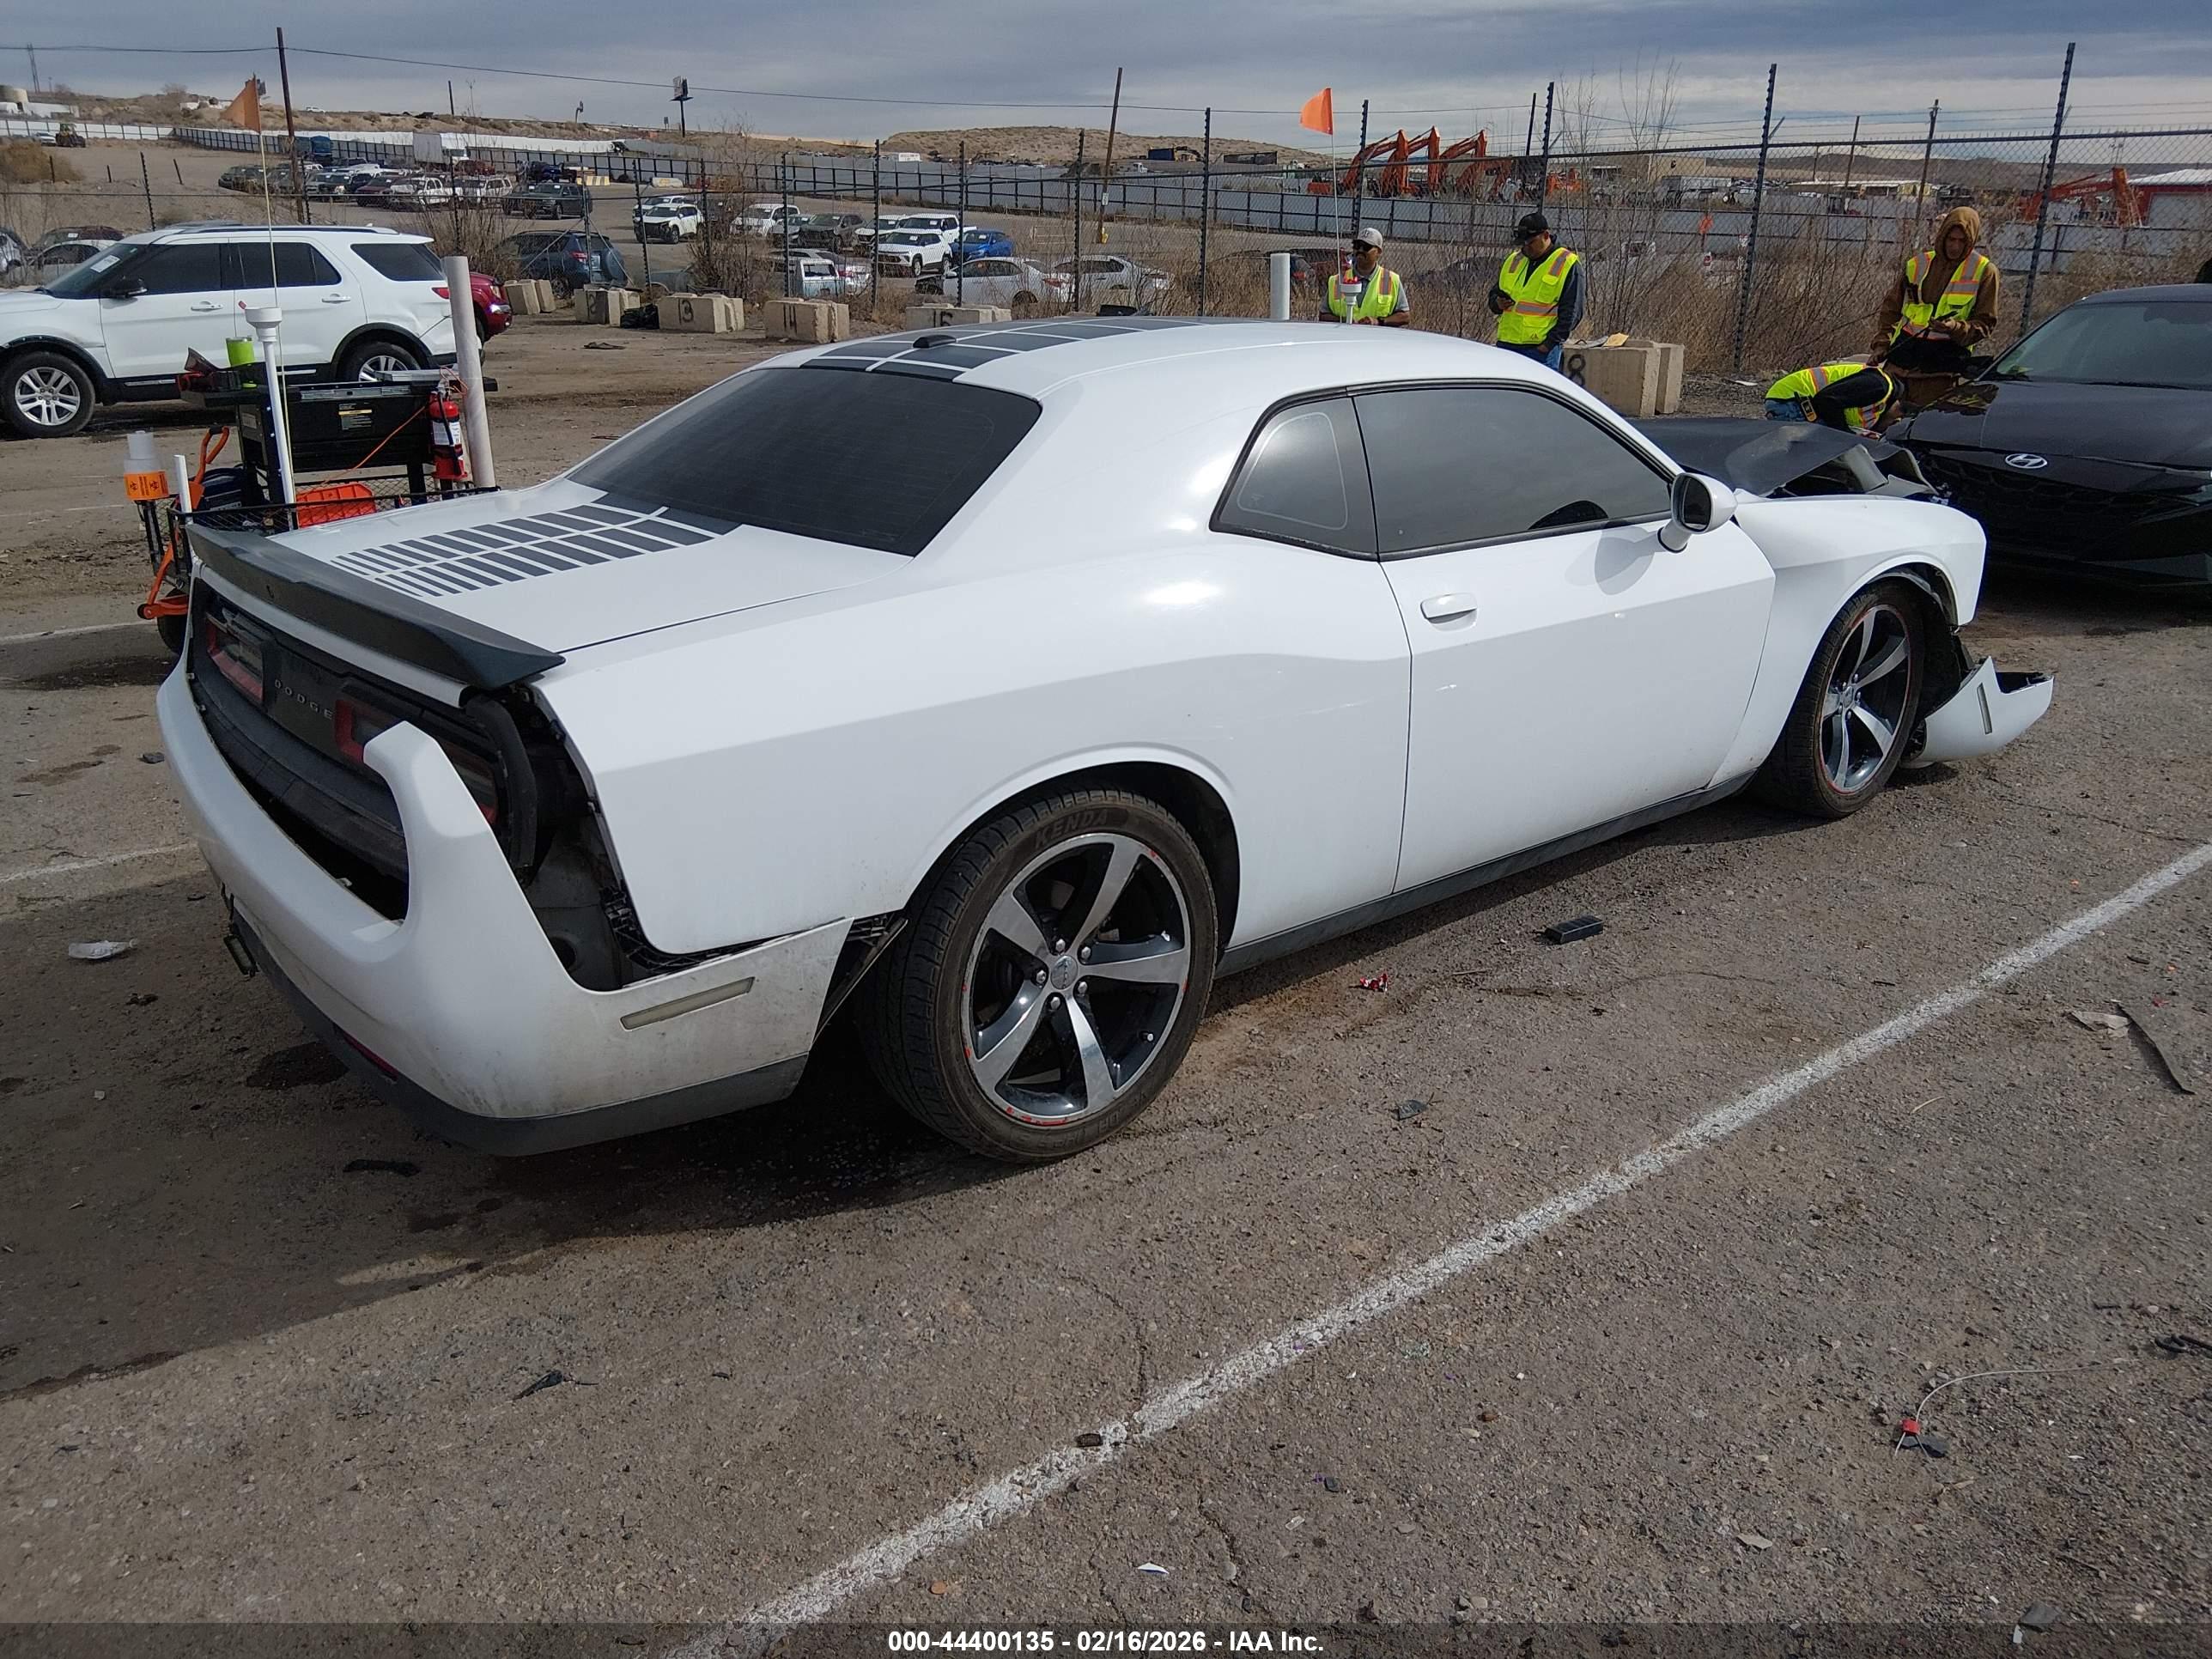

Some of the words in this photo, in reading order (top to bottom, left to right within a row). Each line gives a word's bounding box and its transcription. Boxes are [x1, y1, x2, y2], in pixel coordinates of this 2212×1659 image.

[678, 298, 694, 325] 13
[275, 678, 333, 720] DODGE
[1035, 810, 1109, 848] KENDA
